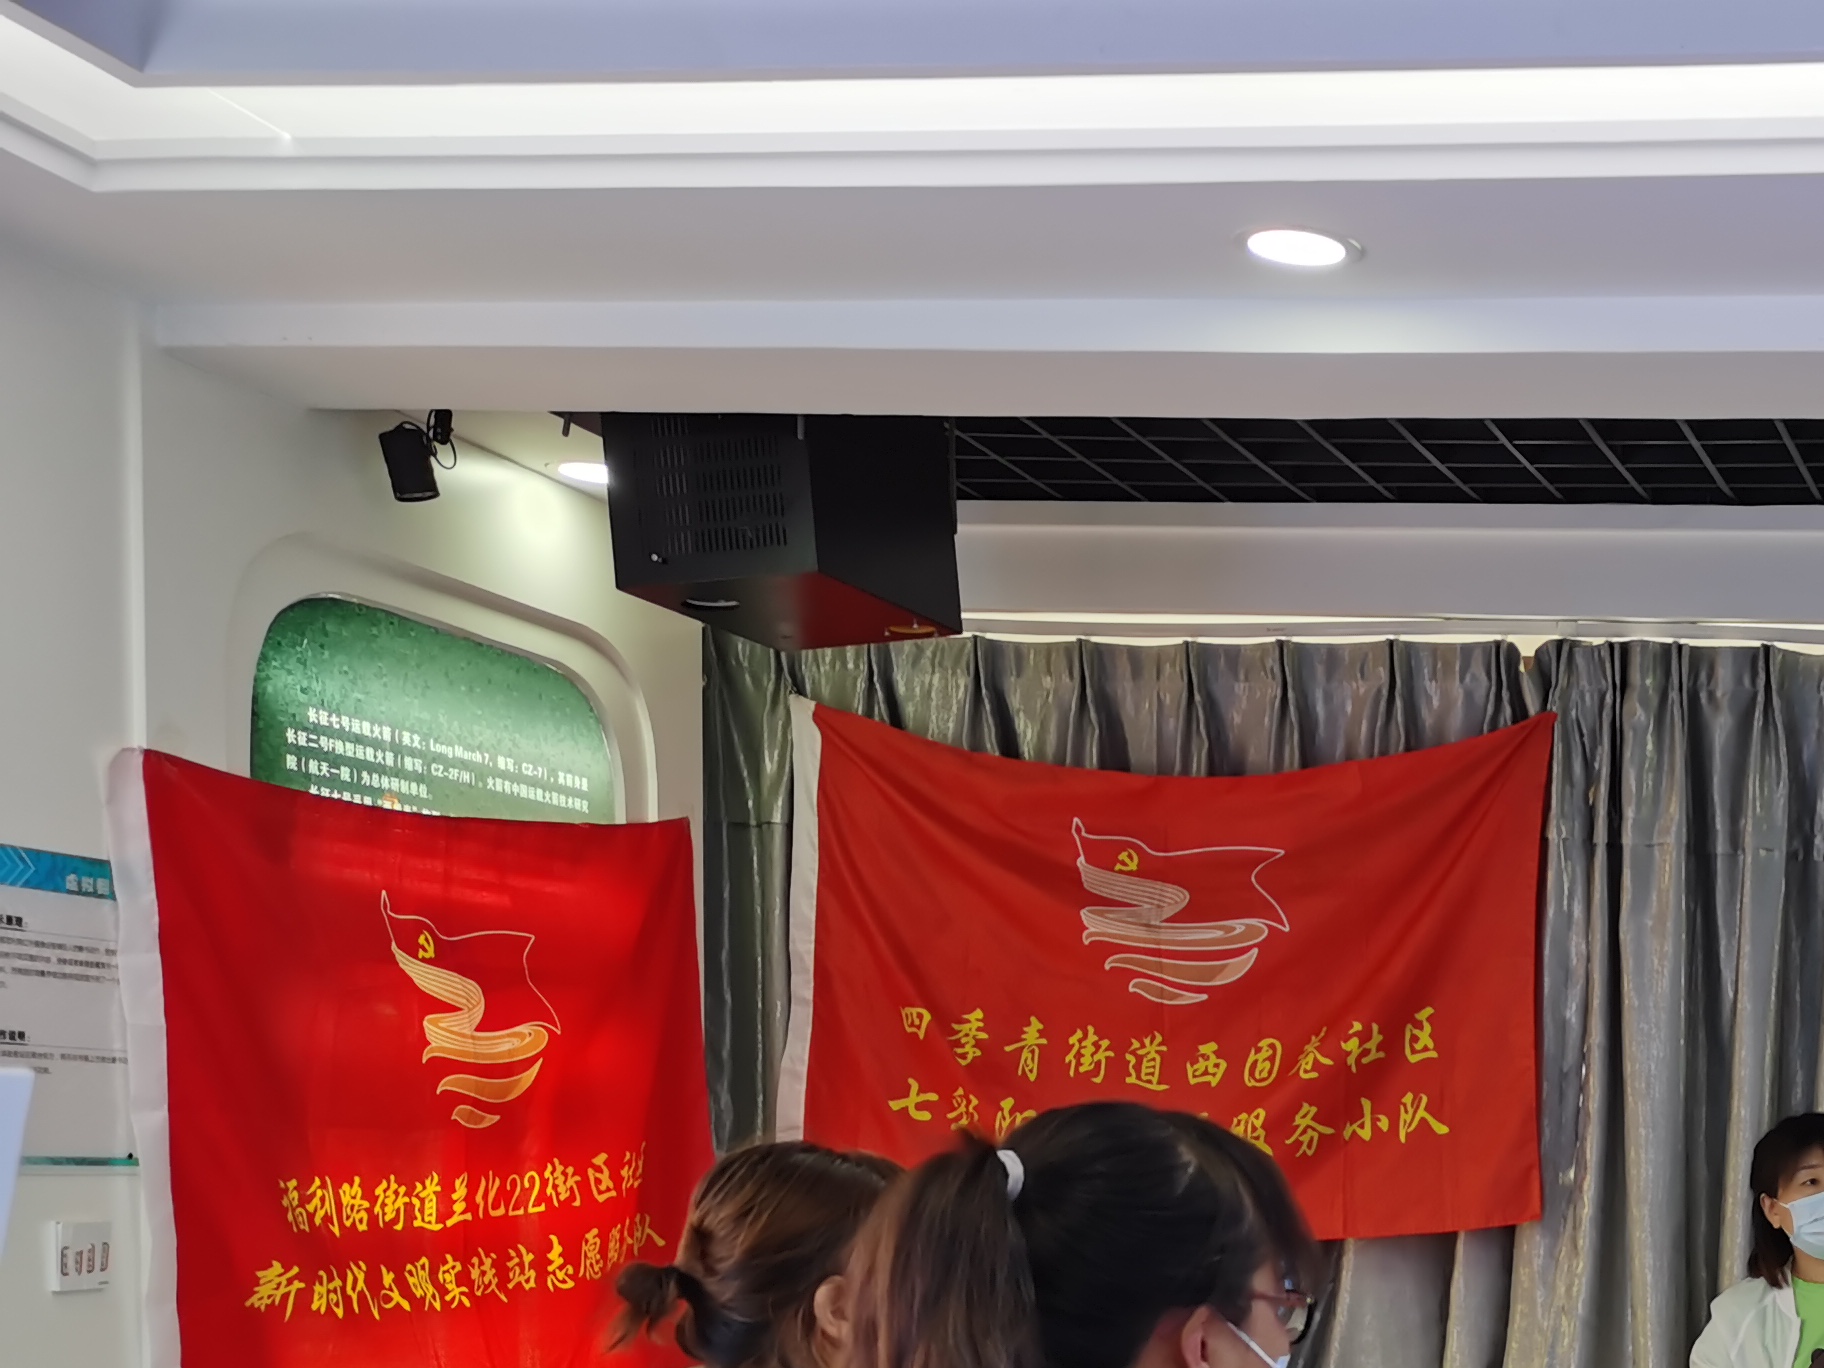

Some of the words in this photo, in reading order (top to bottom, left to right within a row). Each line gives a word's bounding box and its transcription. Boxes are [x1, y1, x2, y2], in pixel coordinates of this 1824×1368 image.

[900, 1006, 1440, 1092] 四季青街道西固巷社区
[888, 1077, 1450, 1158] 七彩阳服务小队
